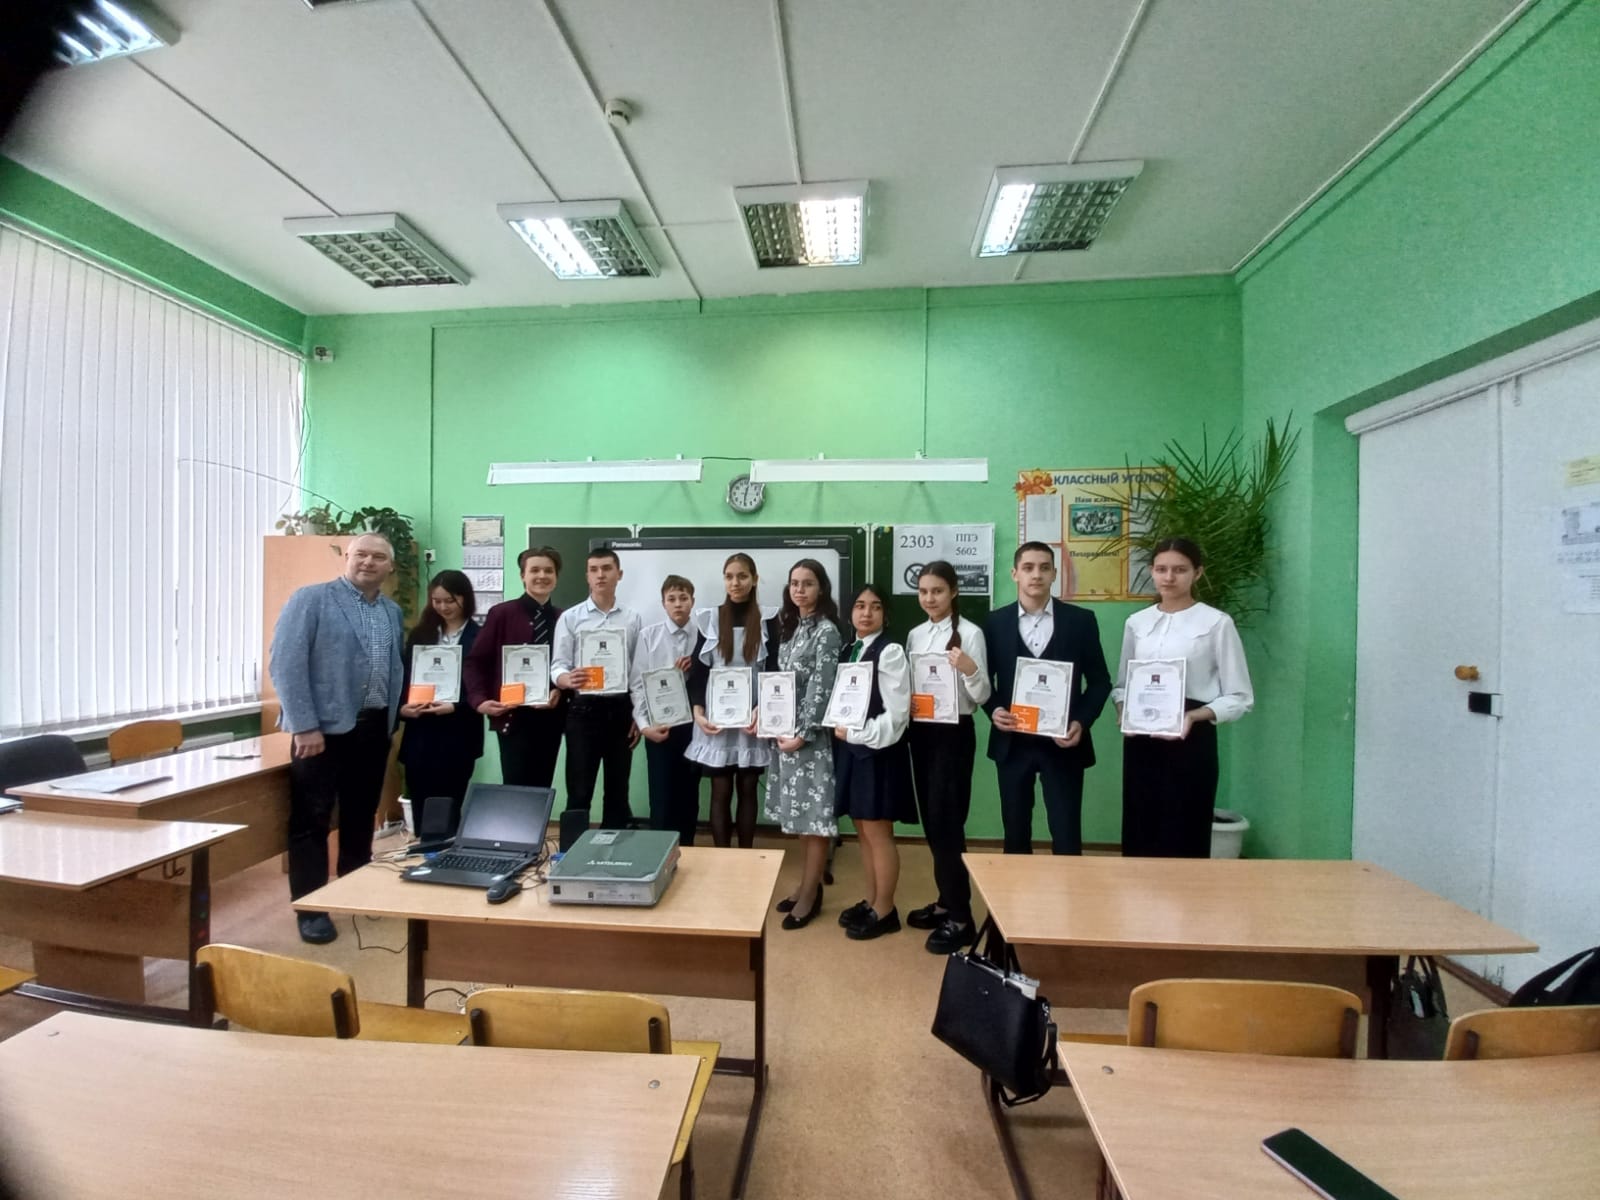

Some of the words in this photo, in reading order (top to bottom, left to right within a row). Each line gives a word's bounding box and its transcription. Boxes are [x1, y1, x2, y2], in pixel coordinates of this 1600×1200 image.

[1054, 472, 1118, 485] КЛАССНЫЙ
[900, 535, 934, 549] 2303
[956, 533, 978, 542] ППЭ
[955, 547, 977, 556] 5602
